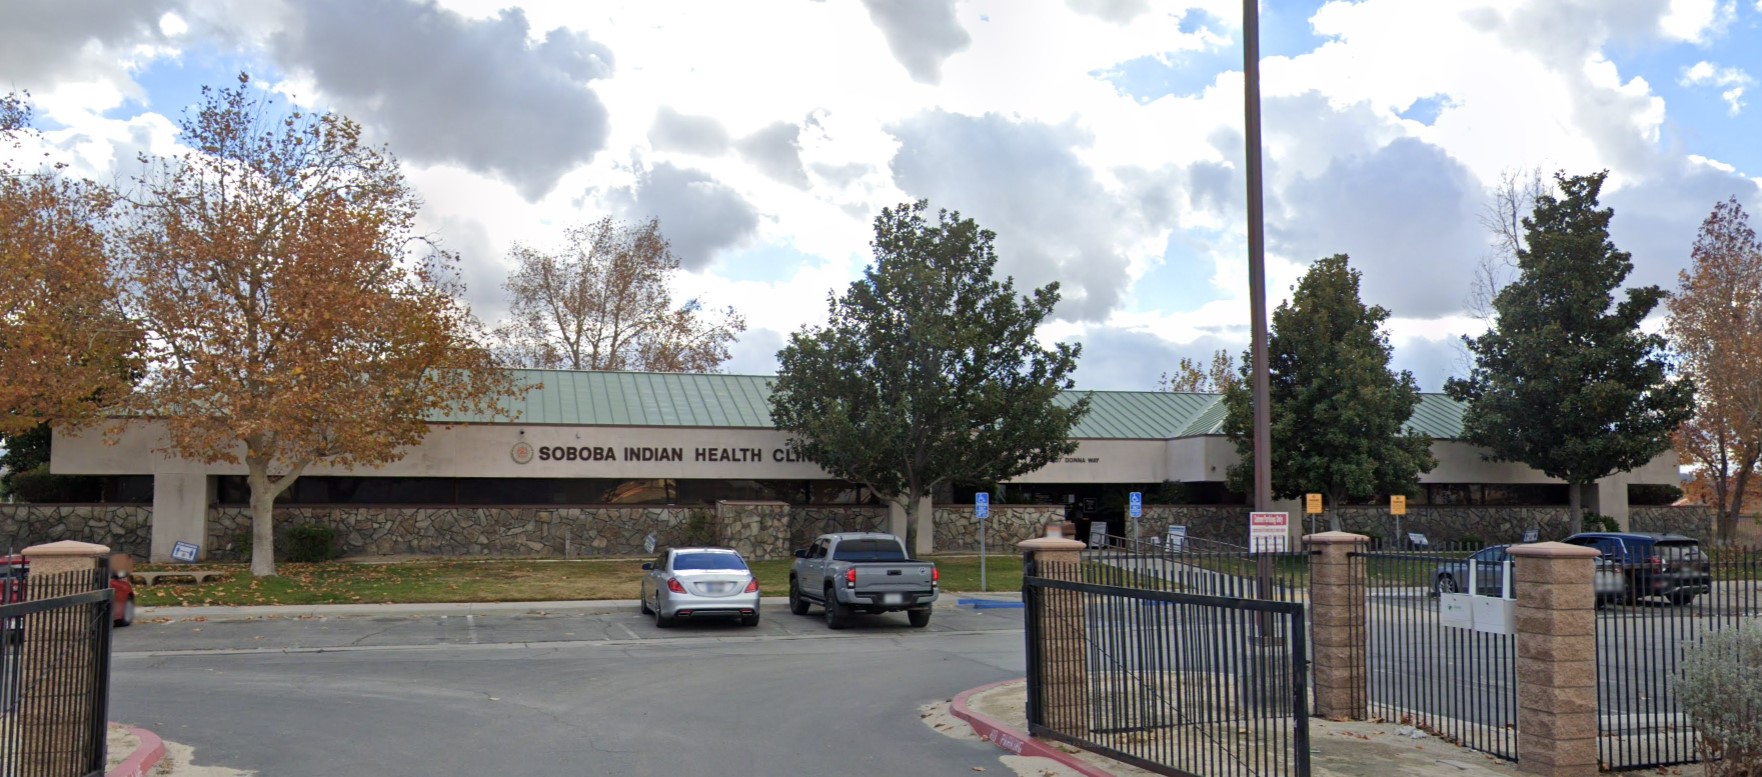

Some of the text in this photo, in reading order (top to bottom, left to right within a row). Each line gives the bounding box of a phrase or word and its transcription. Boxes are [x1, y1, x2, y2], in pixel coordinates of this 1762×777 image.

[538, 446, 616, 461] SOBOBA
[624, 447, 683, 462] INDIAN
[694, 447, 762, 462] HEALTH
[999, 733, 1025, 754] PARKING
